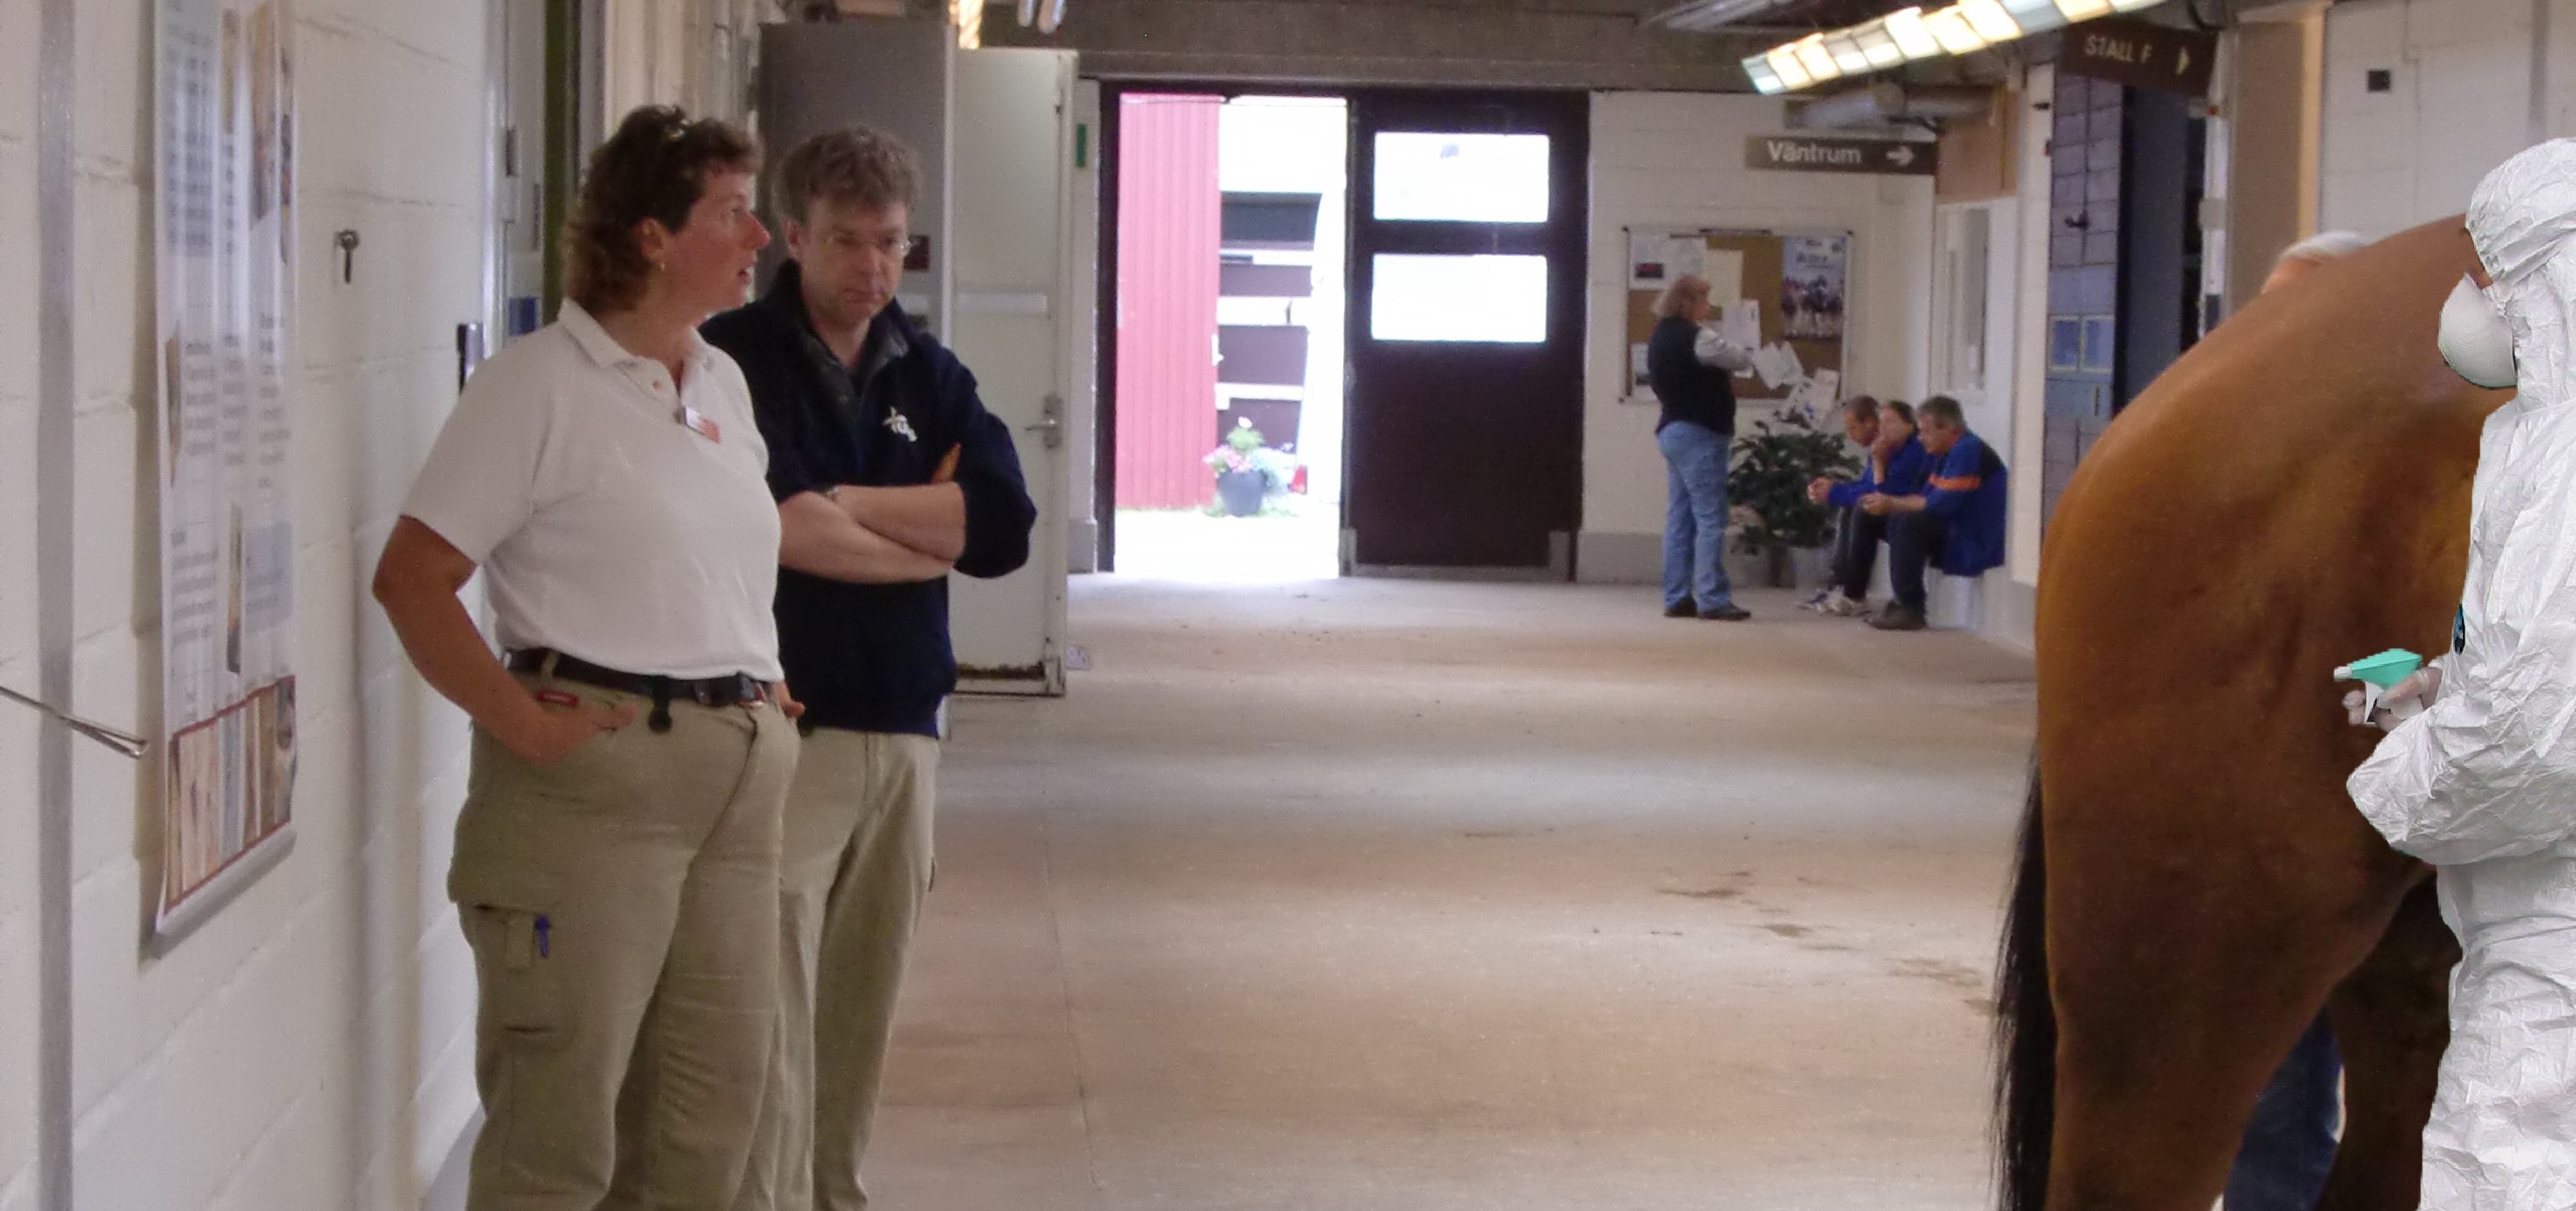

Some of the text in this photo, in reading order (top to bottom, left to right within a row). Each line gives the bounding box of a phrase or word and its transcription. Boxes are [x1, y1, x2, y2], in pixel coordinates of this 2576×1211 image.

[2085, 35, 2153, 63] STALL F
[1767, 140, 1862, 163] Väntrum
